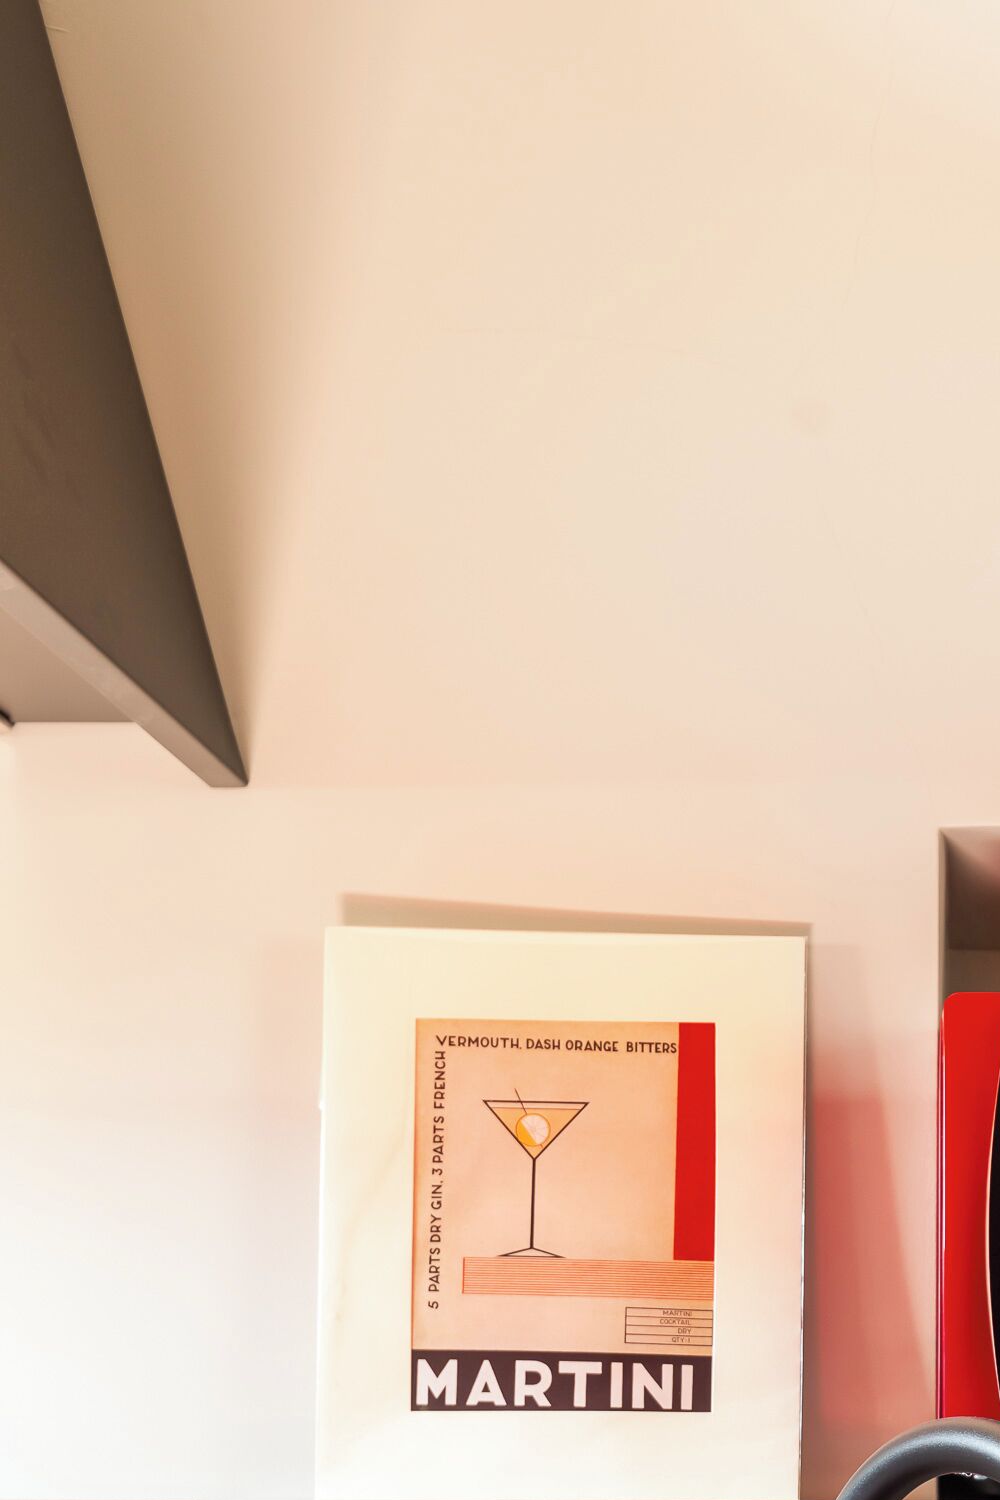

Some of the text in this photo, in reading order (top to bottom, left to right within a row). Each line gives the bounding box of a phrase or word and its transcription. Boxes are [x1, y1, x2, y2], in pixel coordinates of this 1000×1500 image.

[526, 1038, 561, 1050] DASH
[566, 1039, 619, 1053] ORANGE
[626, 1041, 678, 1054] BITTERS
[434, 1050, 446, 1109] FRENCH
[432, 1115, 445, 1163] PARTS
[432, 1168, 443, 1176] 3
[430, 1214, 442, 1243] DRY
[428, 1247, 441, 1292] PARTS
[428, 1301, 439, 1310] 5
[660, 1318, 692, 1326] COCKTAIL
[677, 1327, 692, 1335] DRY
[415, 1358, 694, 1411] MARTINI
